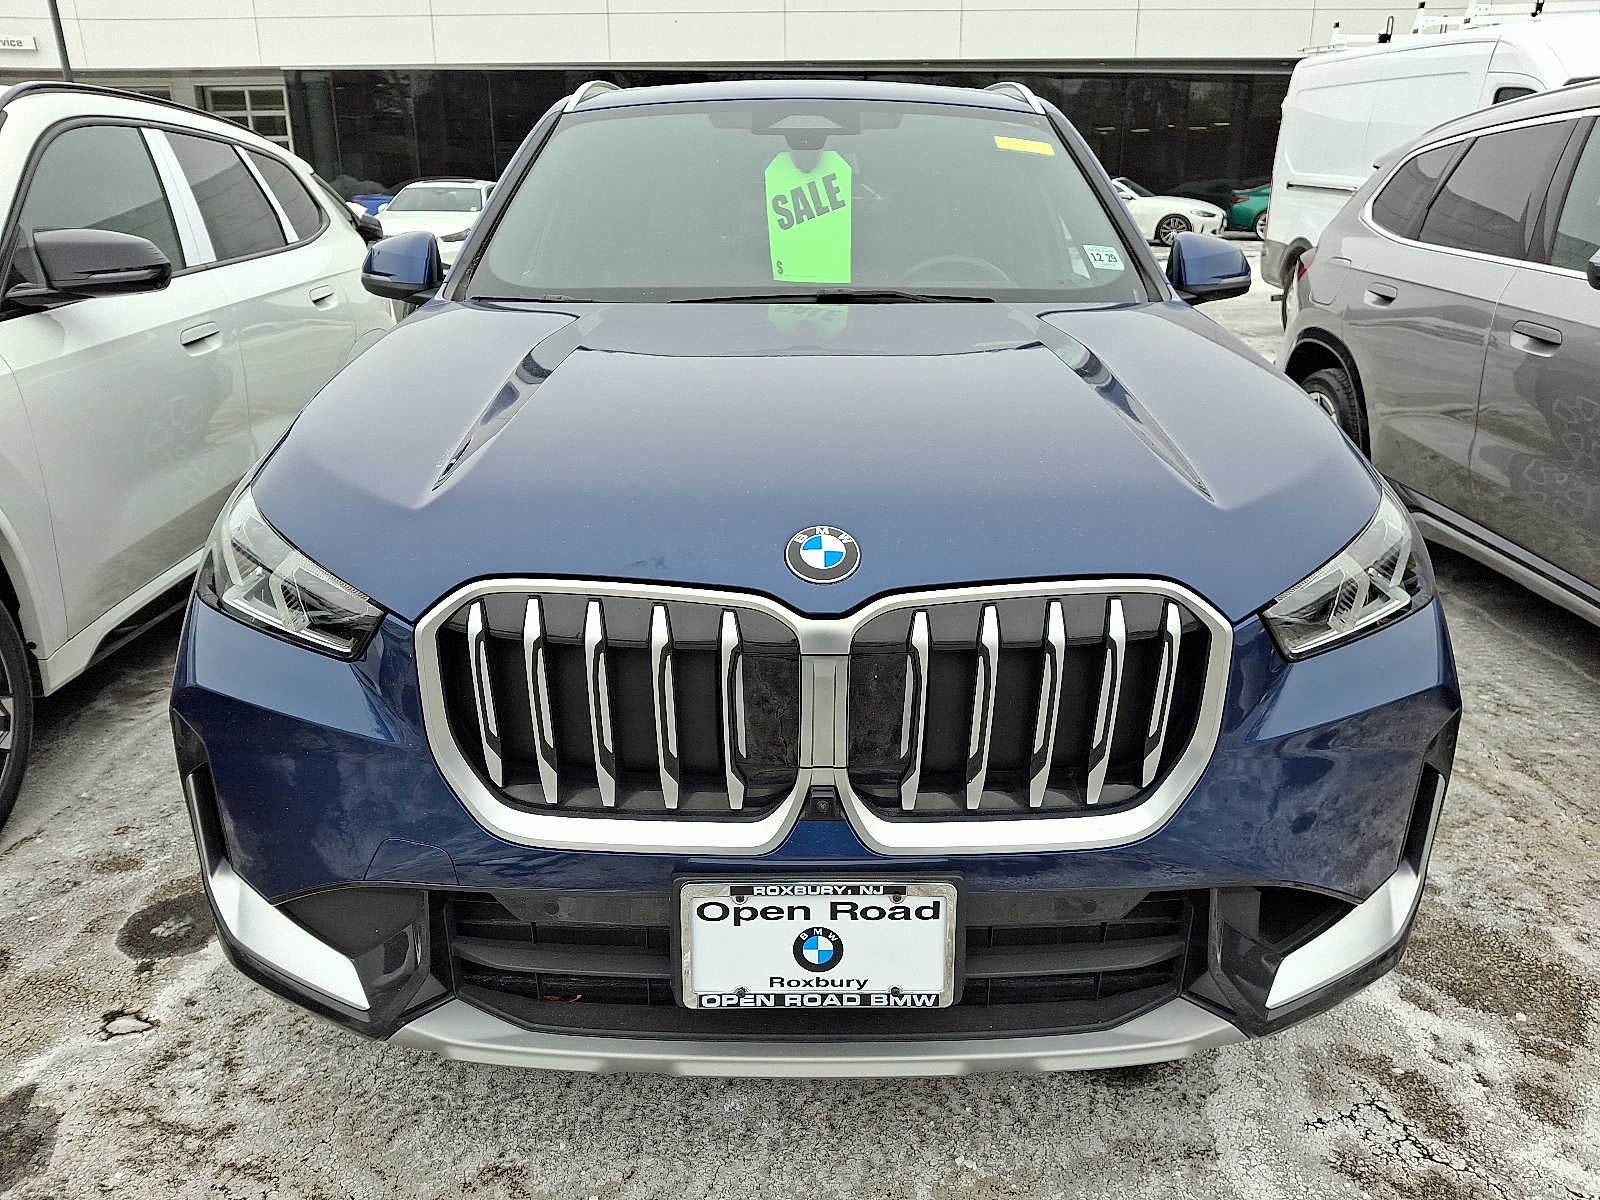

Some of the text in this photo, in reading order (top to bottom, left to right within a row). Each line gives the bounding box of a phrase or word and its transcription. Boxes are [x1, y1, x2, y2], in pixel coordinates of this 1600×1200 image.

[772, 173, 846, 230] SALE
[776, 260, 784, 275] $
[794, 527, 853, 543] BMW
[859, 886, 884, 895] NJ
[696, 901, 940, 926] Open Road
[800, 927, 839, 941] BMW
[769, 976, 869, 990] Roxbury
[701, 993, 938, 1008] OPEN ROAD BMW
